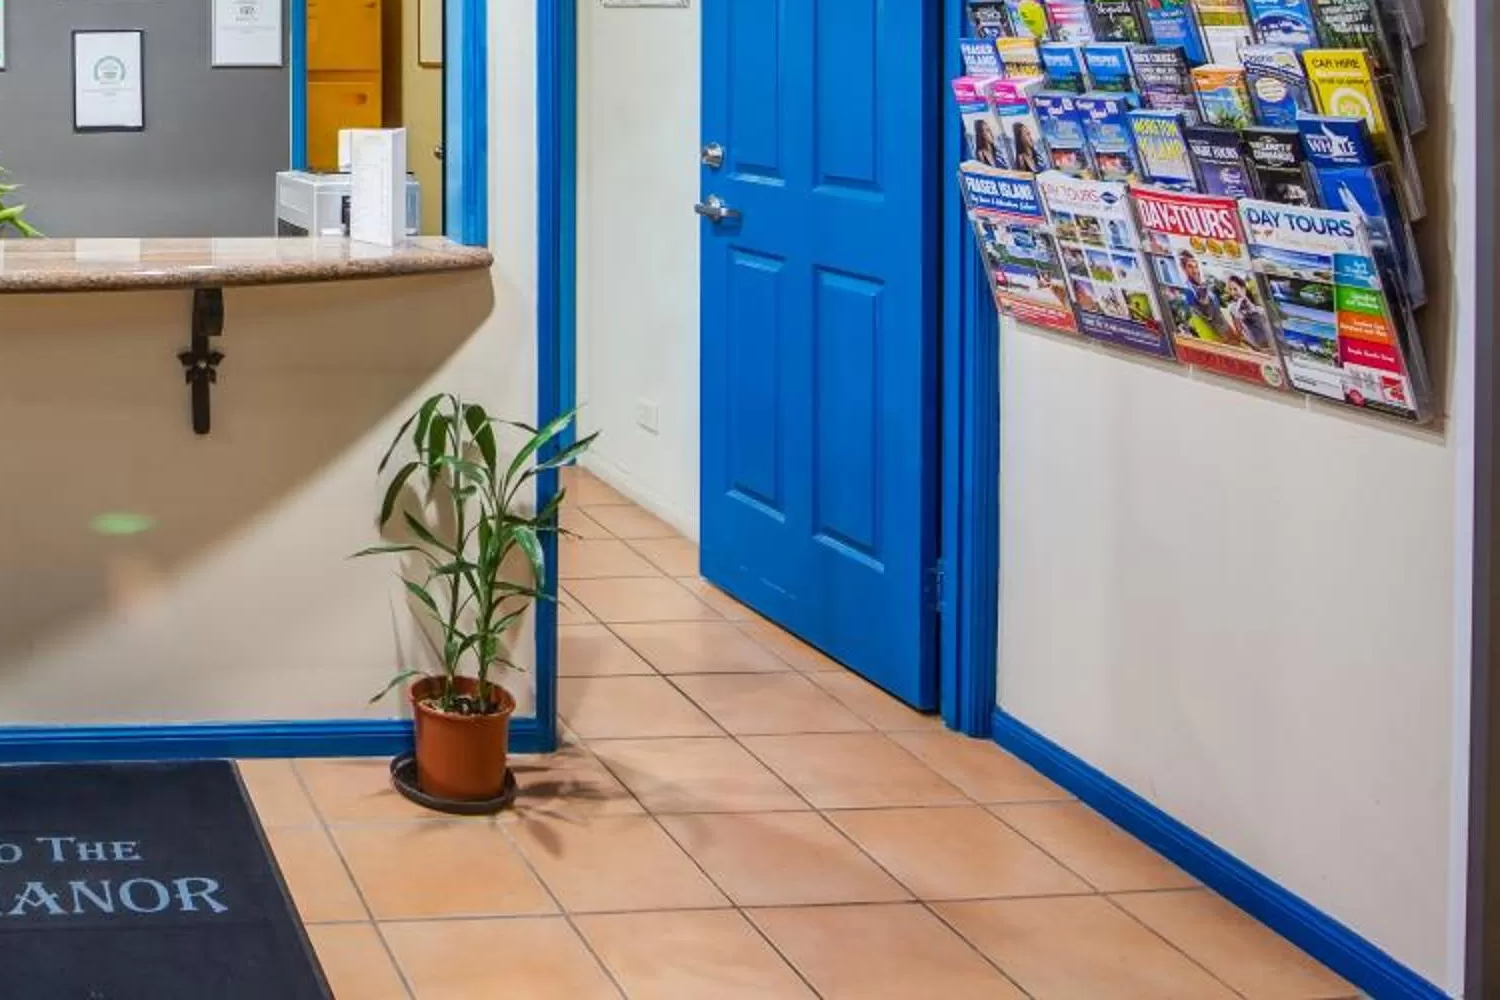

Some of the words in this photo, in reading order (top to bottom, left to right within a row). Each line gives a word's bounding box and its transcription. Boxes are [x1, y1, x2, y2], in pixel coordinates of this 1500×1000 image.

[1312, 58, 1335, 69] CAR
[1335, 58, 1361, 69] HIRE
[965, 176, 999, 195] FRASER
[999, 179, 1035, 200] ISLAND
[1139, 199, 1173, 231] DAY
[1171, 203, 1237, 239] TOURS
[1245, 207, 1281, 229] DAY
[1283, 213, 1355, 238] TOURS
